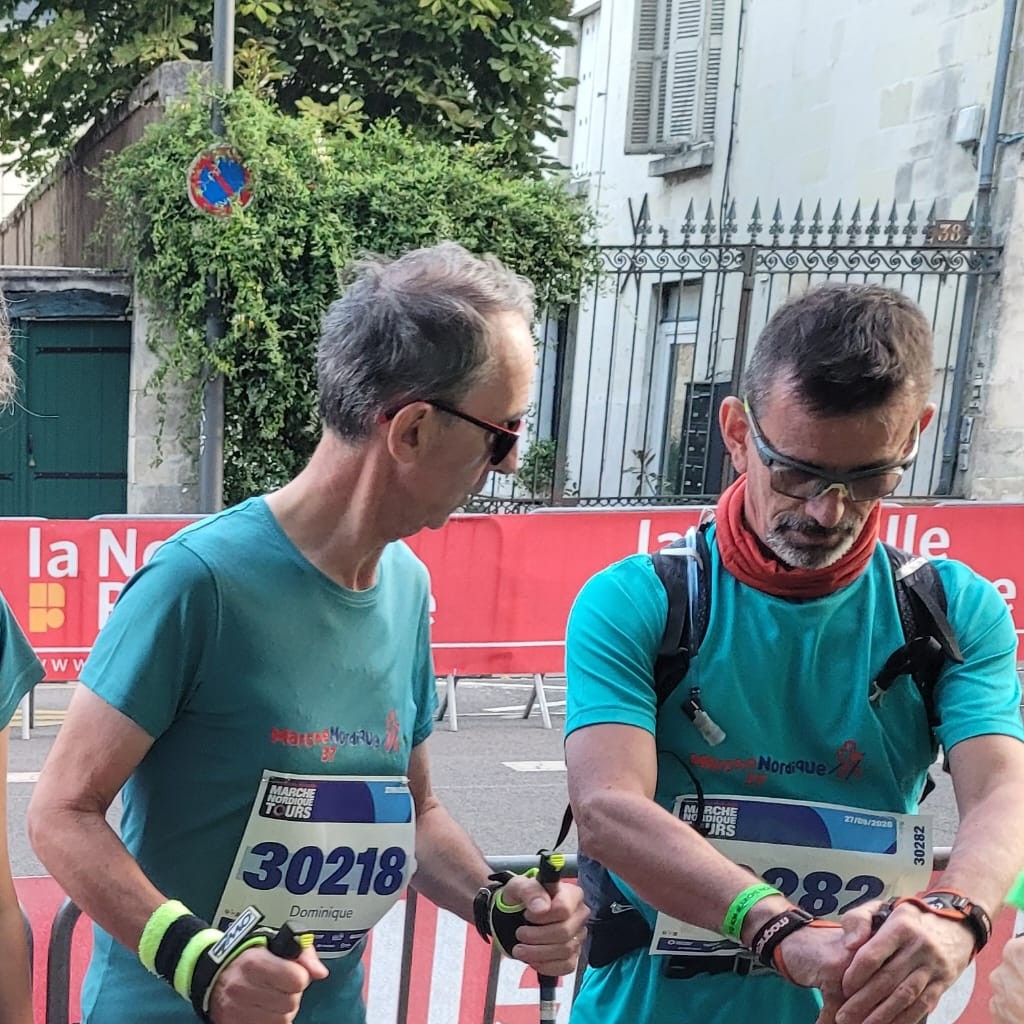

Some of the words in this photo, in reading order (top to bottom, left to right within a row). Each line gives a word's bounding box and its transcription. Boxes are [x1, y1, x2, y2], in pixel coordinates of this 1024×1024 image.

[938, 223, 962, 242] 38
[28, 527, 79, 578] la
[267, 794, 314, 807] NORDIQUE
[269, 785, 317, 799] MARCHE
[265, 802, 313, 819] TOURS
[682, 813, 738, 825] NODIQUE
[913, 825, 926, 866] 30282
[242, 841, 407, 896] 30218
[761, 866, 885, 917] 282
[289, 905, 353, 921] Dominique
